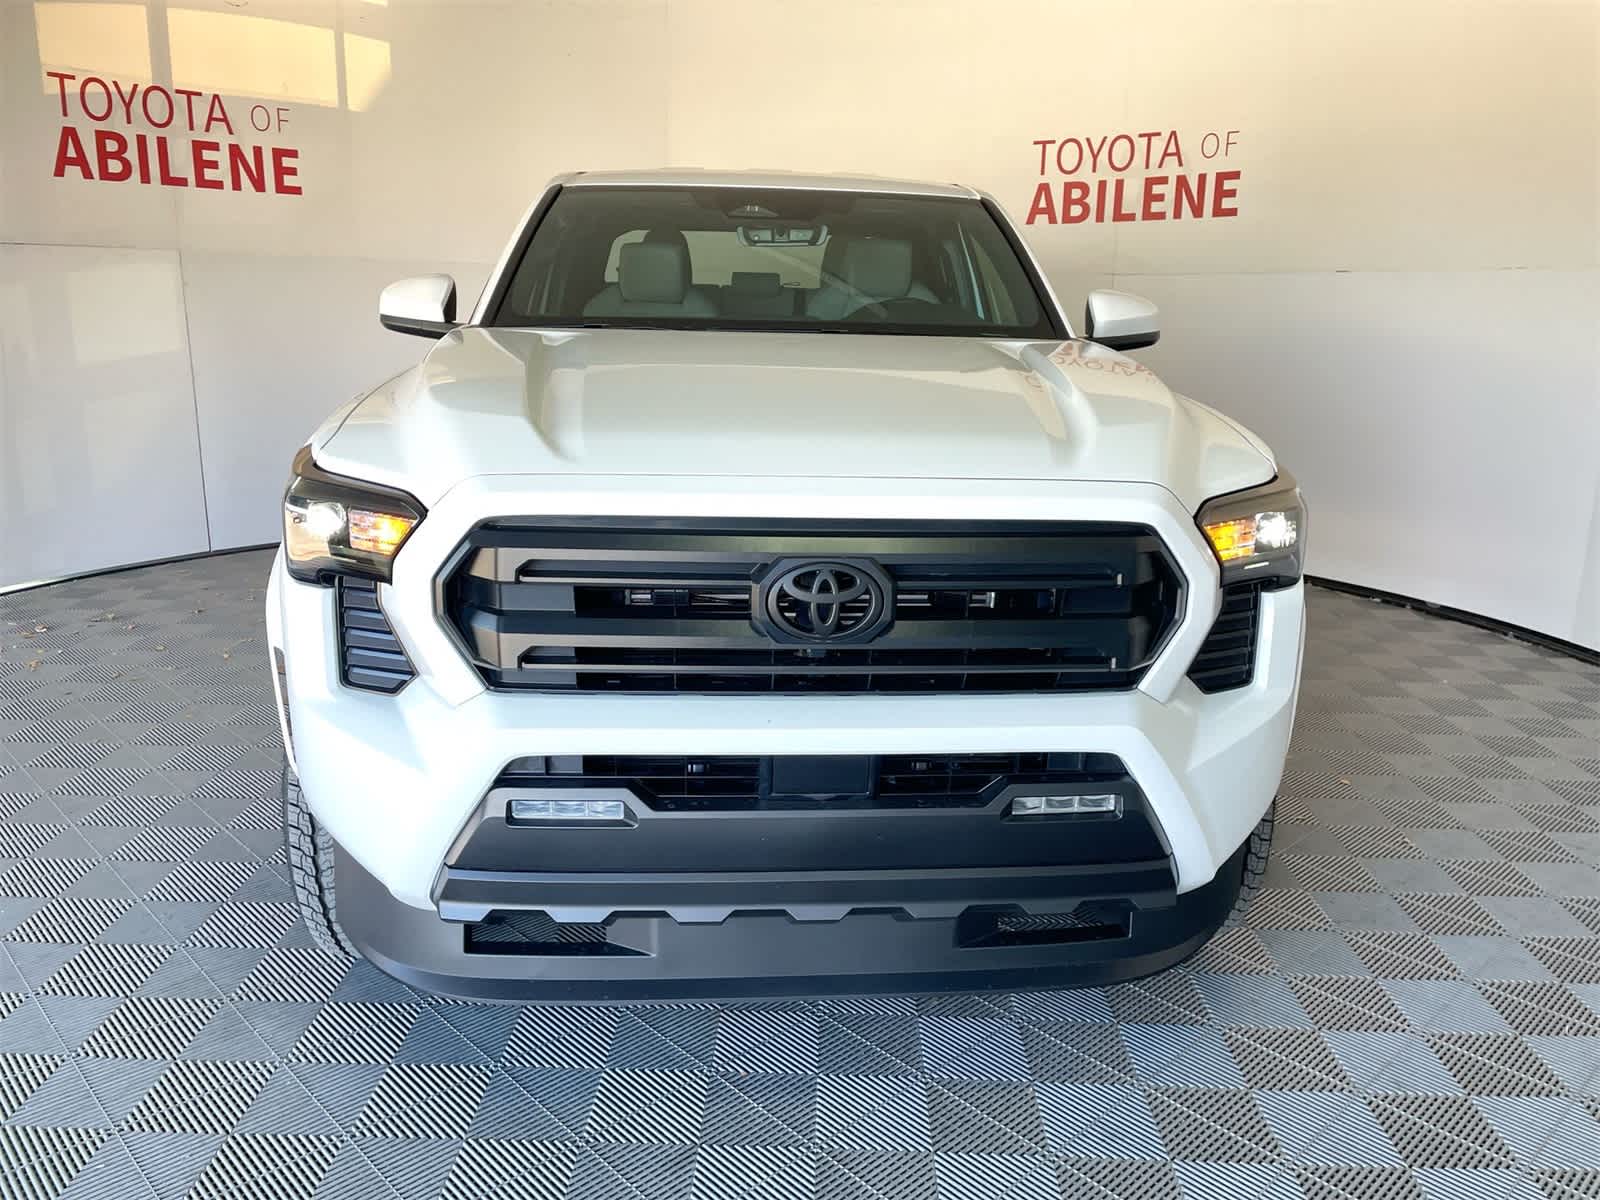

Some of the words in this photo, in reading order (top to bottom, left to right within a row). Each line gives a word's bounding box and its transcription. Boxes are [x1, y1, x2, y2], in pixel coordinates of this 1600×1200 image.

[47, 71, 234, 134] TOYOTA
[251, 105, 290, 133] OF
[53, 126, 302, 195] ABILENE
[1033, 130, 1183, 175] TOYOTA
[1201, 130, 1240, 158] OF
[1026, 171, 1241, 225] ABILENE
